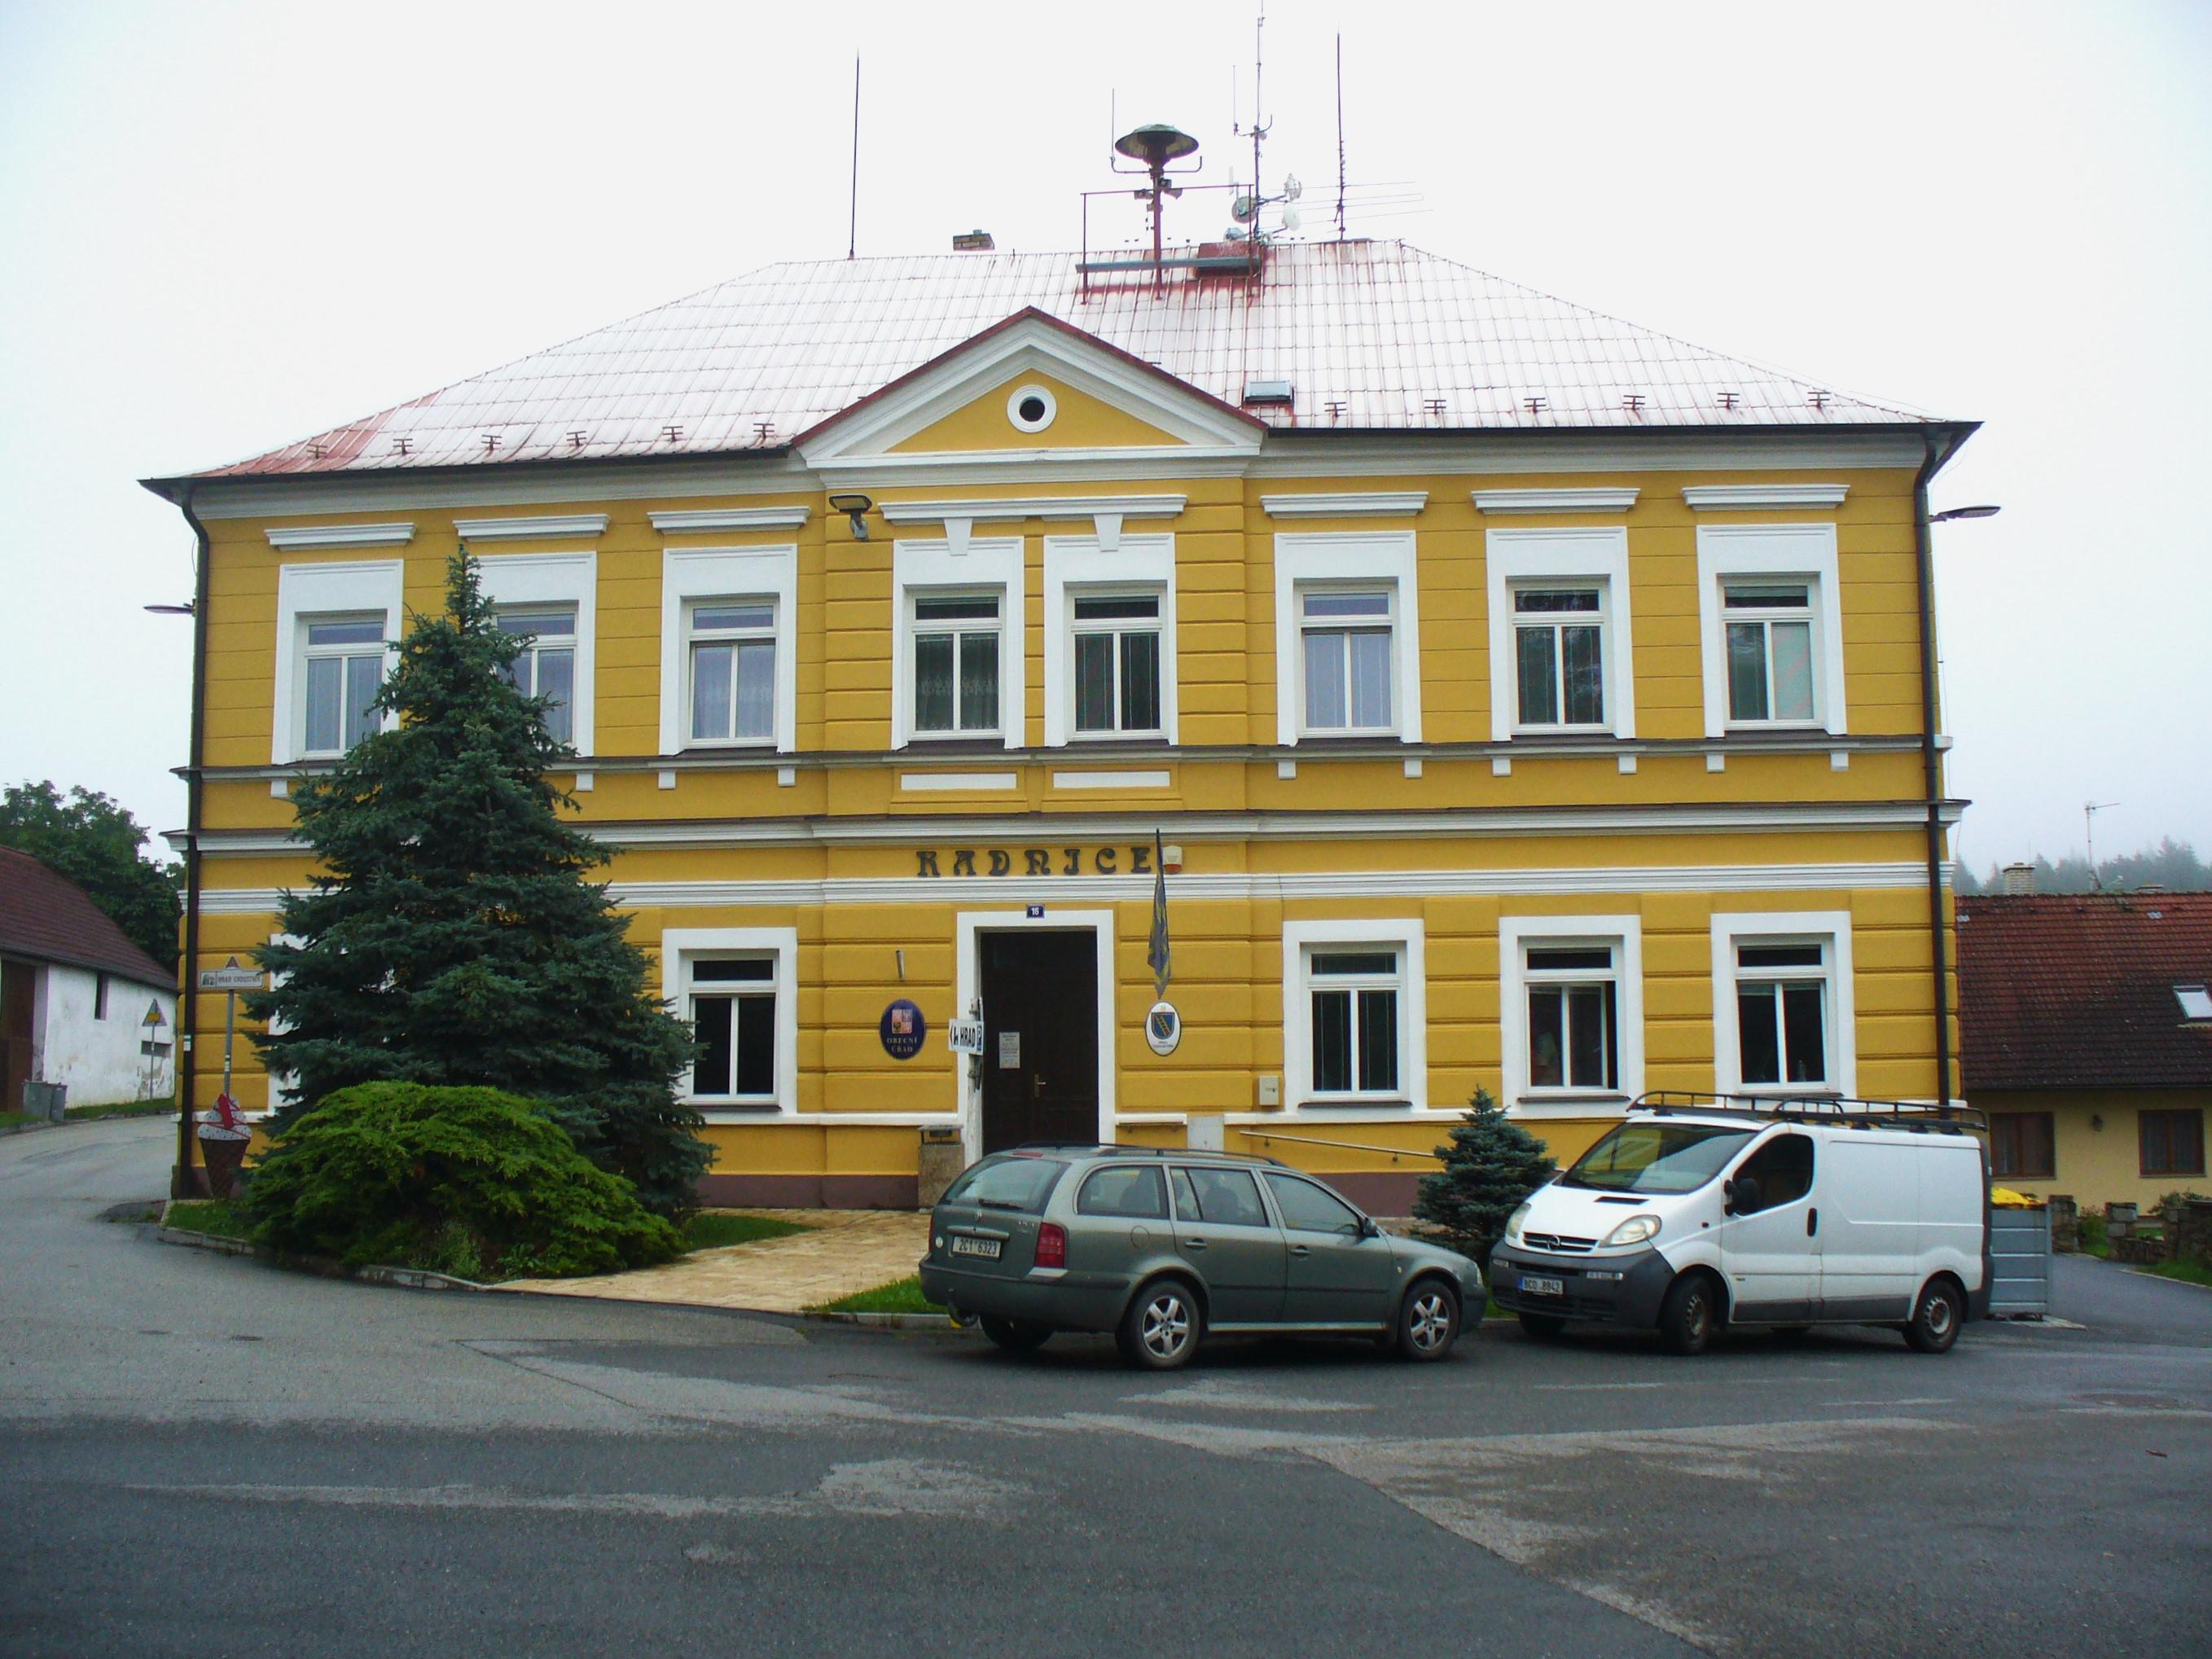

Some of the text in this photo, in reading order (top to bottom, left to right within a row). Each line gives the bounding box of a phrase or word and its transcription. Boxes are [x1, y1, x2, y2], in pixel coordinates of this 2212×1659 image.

[916, 846, 1152, 877] RADNICE
[886, 1036, 918, 1044] OBECNÍ
[959, 1026, 976, 1047] HRAD
[959, 1238, 998, 1255] 2C1 6323
